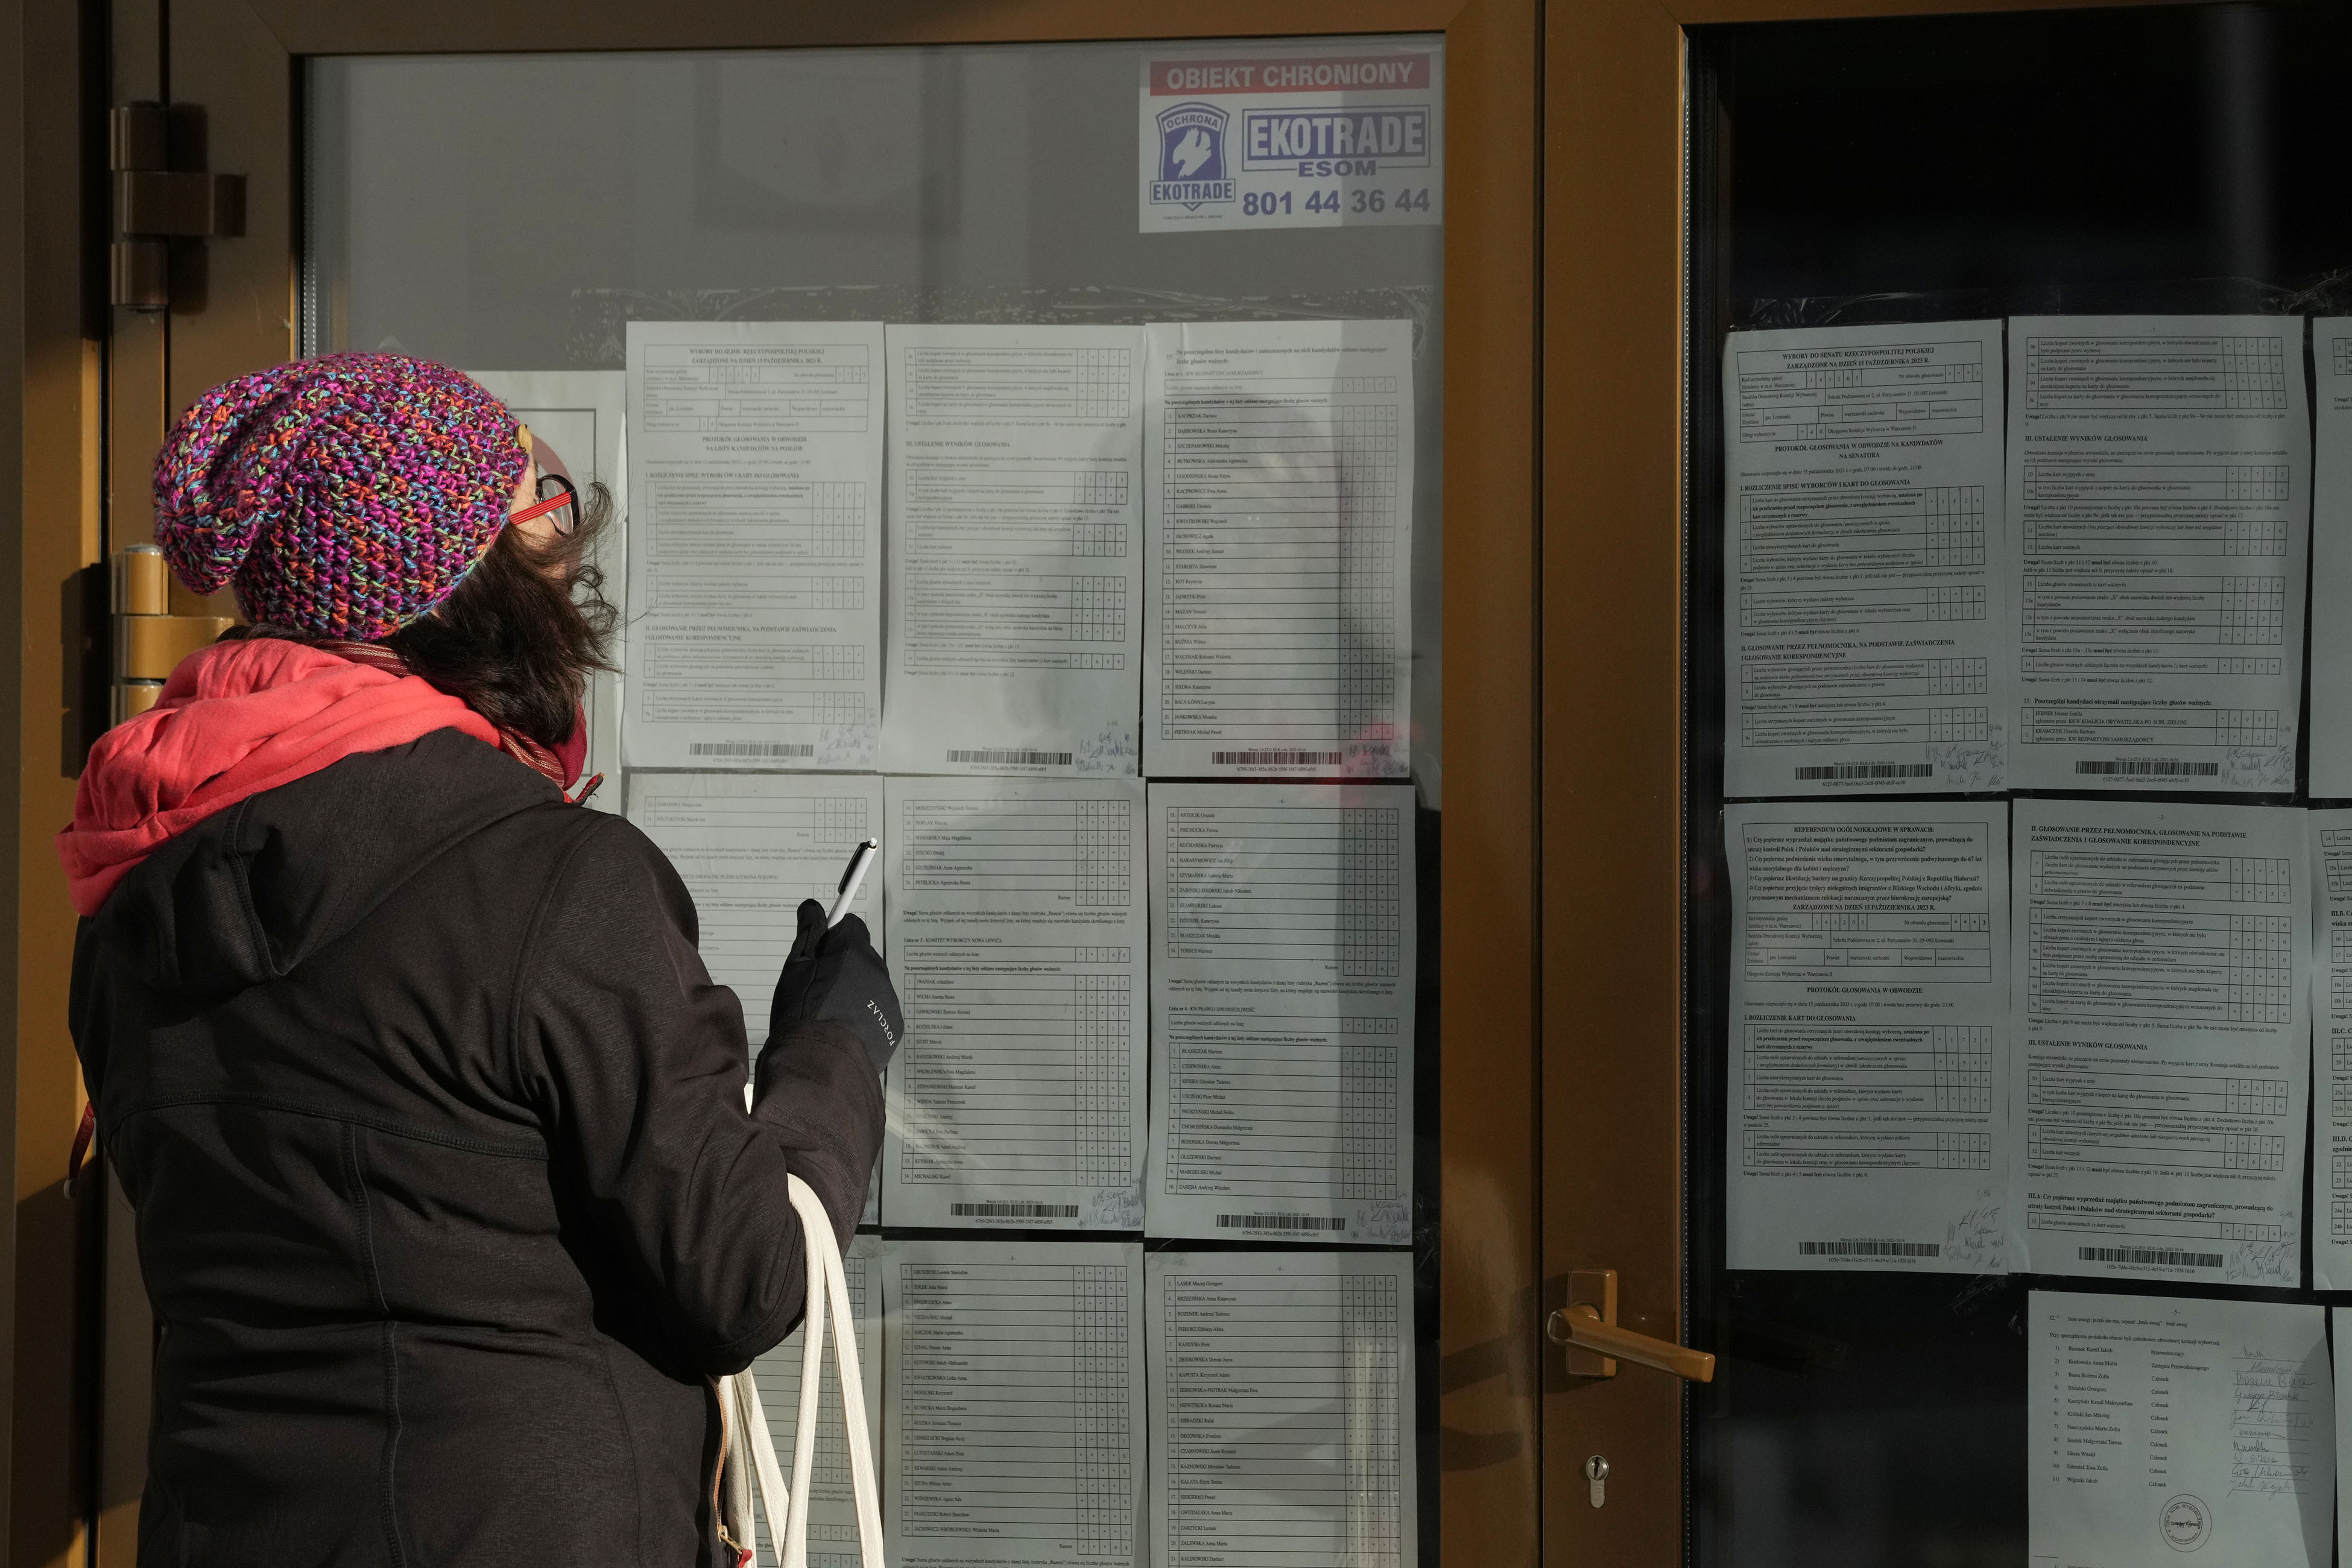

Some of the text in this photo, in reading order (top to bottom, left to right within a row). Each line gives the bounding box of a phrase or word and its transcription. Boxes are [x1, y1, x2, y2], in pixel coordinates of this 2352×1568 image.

[1167, 62, 1414, 89] OBIEKT CHRONIONY
[1166, 115, 1219, 128] OCHRONA
[1250, 116, 1423, 156] EKOTRADE
[1298, 160, 1376, 177] ESOM
[1153, 182, 1232, 201] EKOTRADE
[1243, 188, 1430, 216] 801 44 36 44
[1786, 362, 1828, 370] ZARZĄDZONE
[1900, 438, 1943, 447] KANDYDATÓW
[867, 1000, 895, 1046] FORCLAZ
